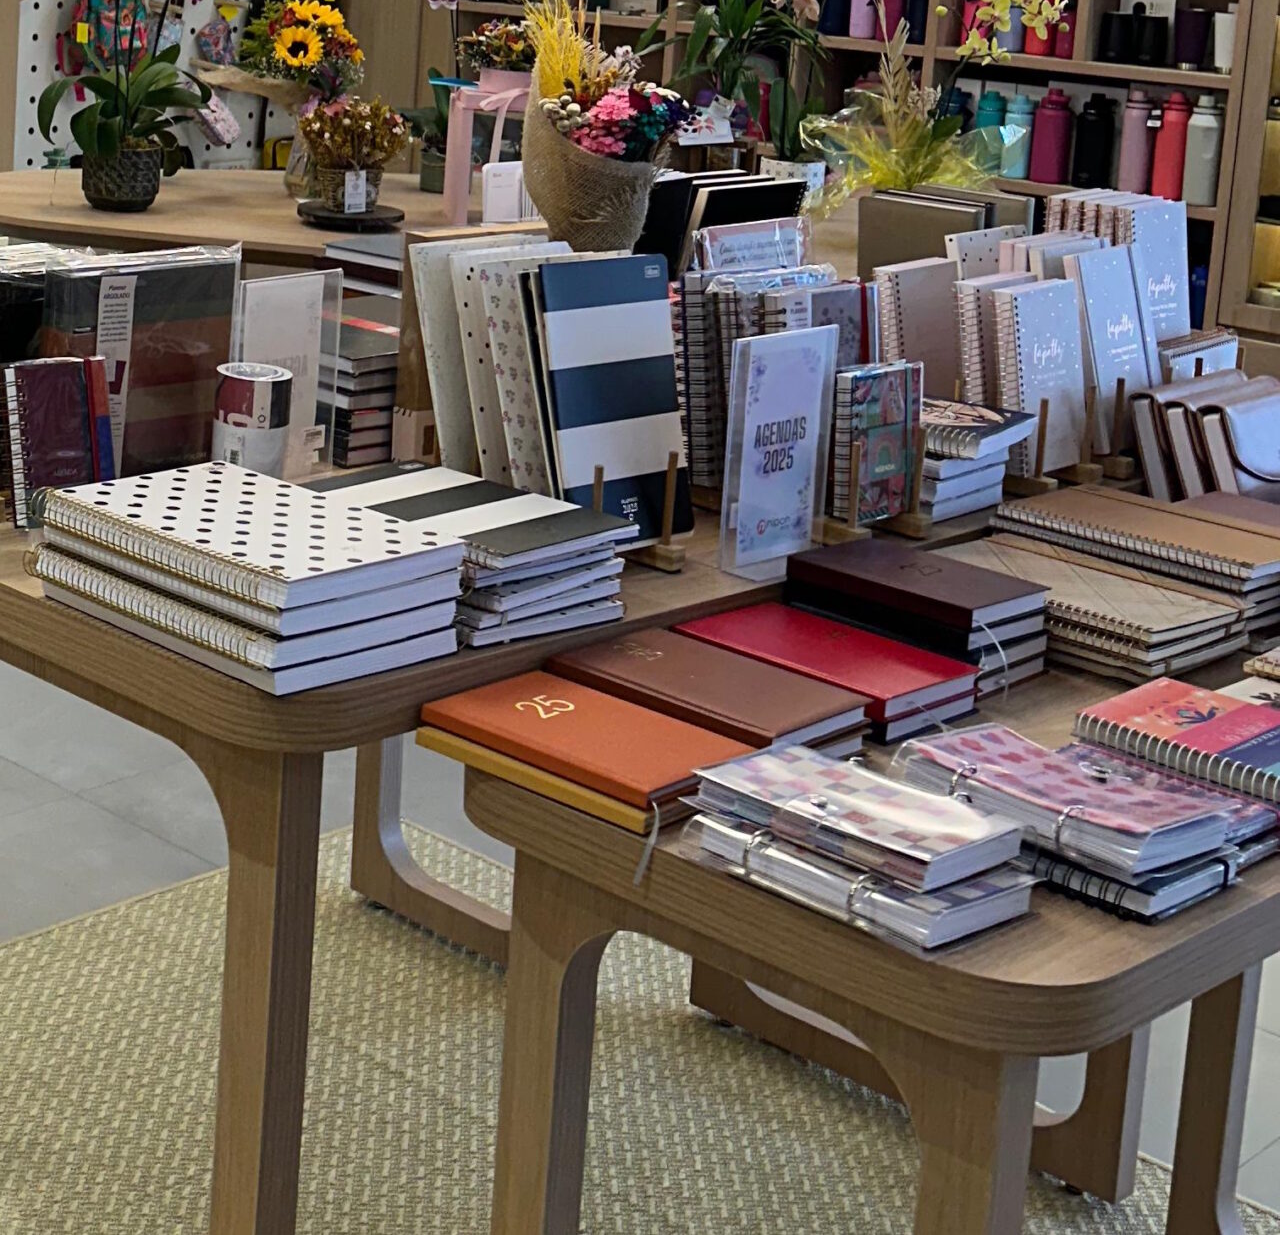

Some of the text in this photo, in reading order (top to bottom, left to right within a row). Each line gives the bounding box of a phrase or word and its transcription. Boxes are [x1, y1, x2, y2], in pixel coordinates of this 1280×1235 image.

[754, 416, 807, 449] AGENDAS
[762, 446, 794, 475] 2025
[515, 694, 575, 719] 25
